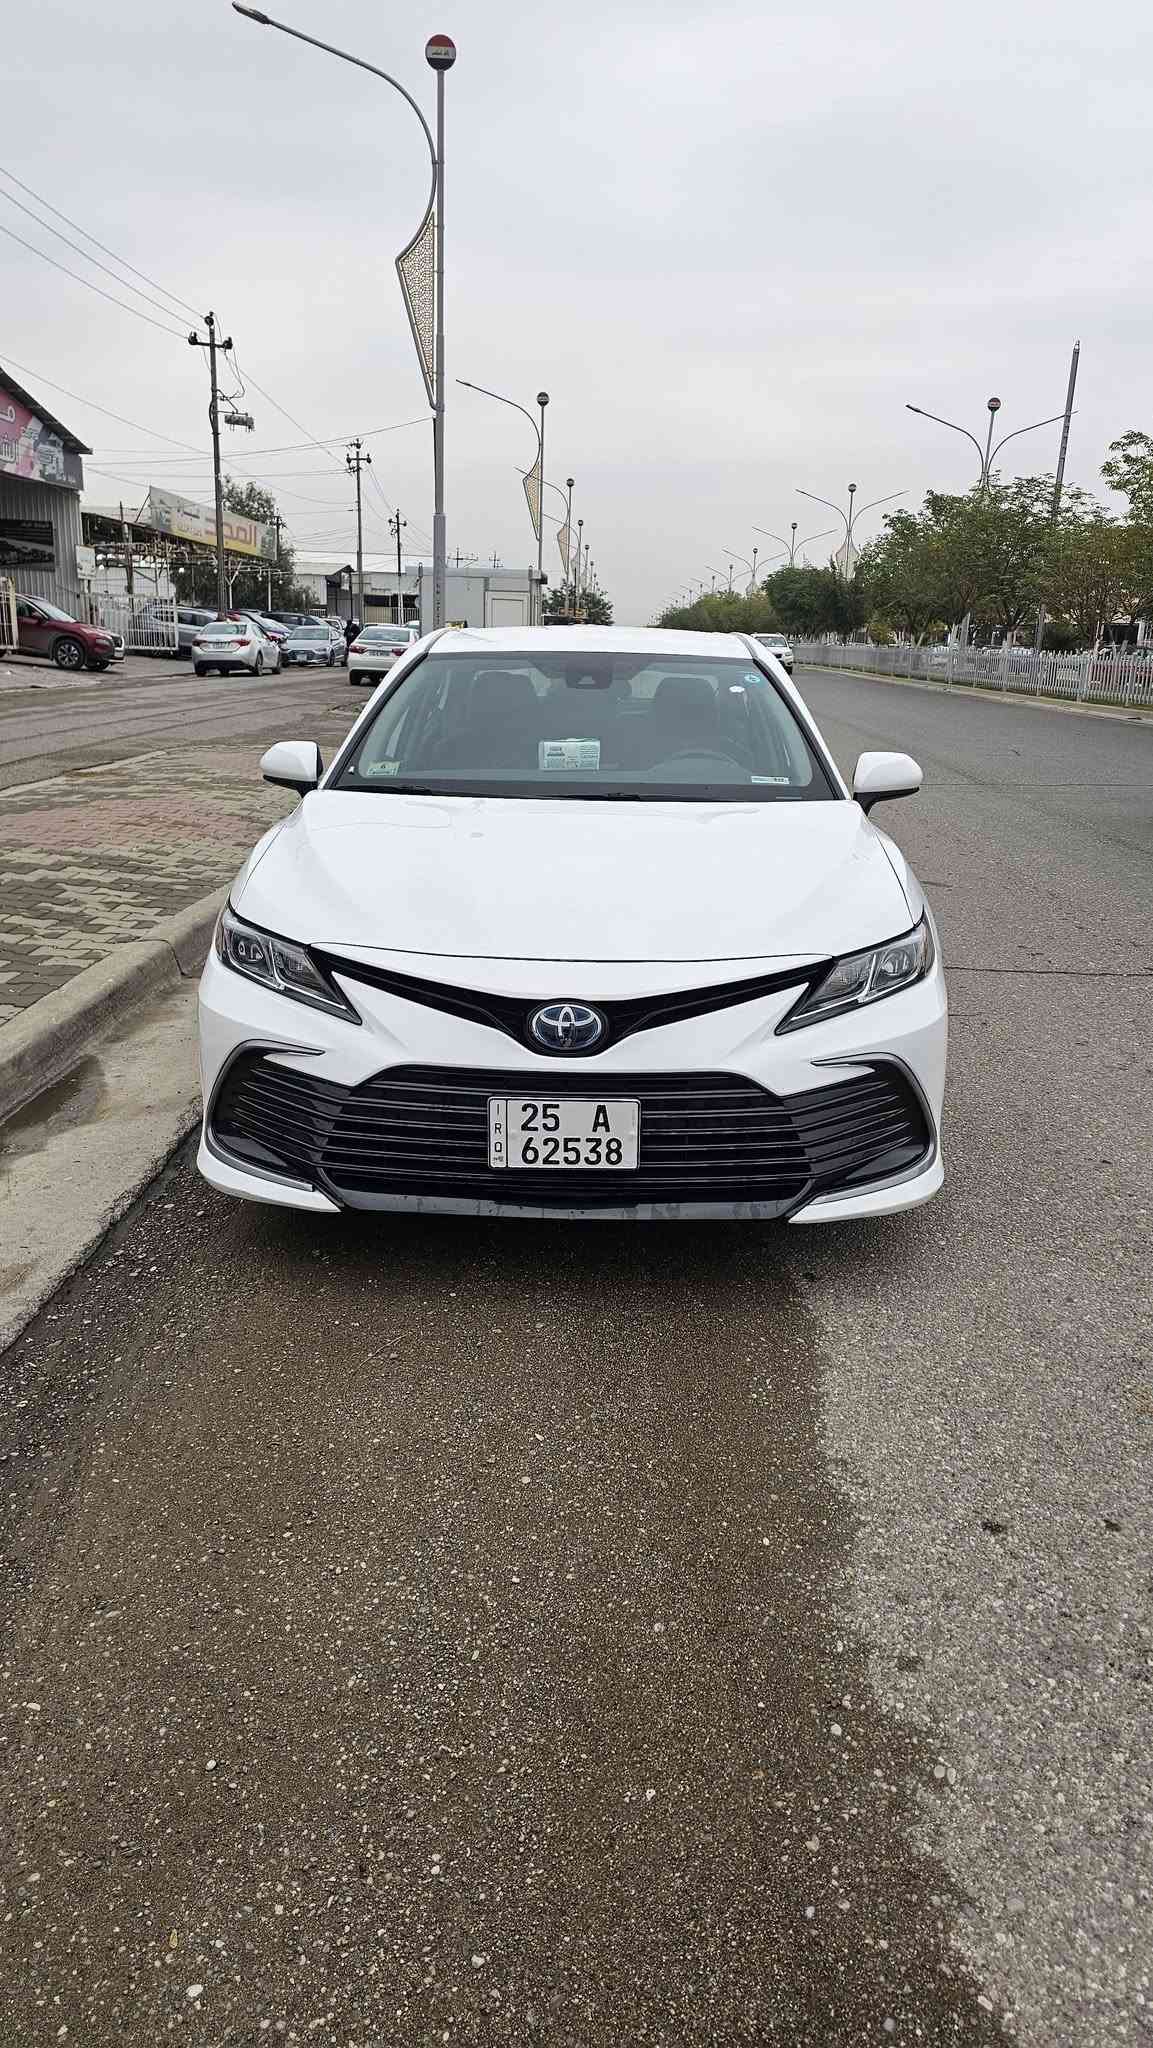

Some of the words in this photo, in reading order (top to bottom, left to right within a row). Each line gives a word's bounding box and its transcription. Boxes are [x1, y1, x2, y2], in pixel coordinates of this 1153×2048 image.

[521, 1103, 560, 1132] 25
[592, 1104, 610, 1132] A
[521, 1137, 623, 1166] 62538
